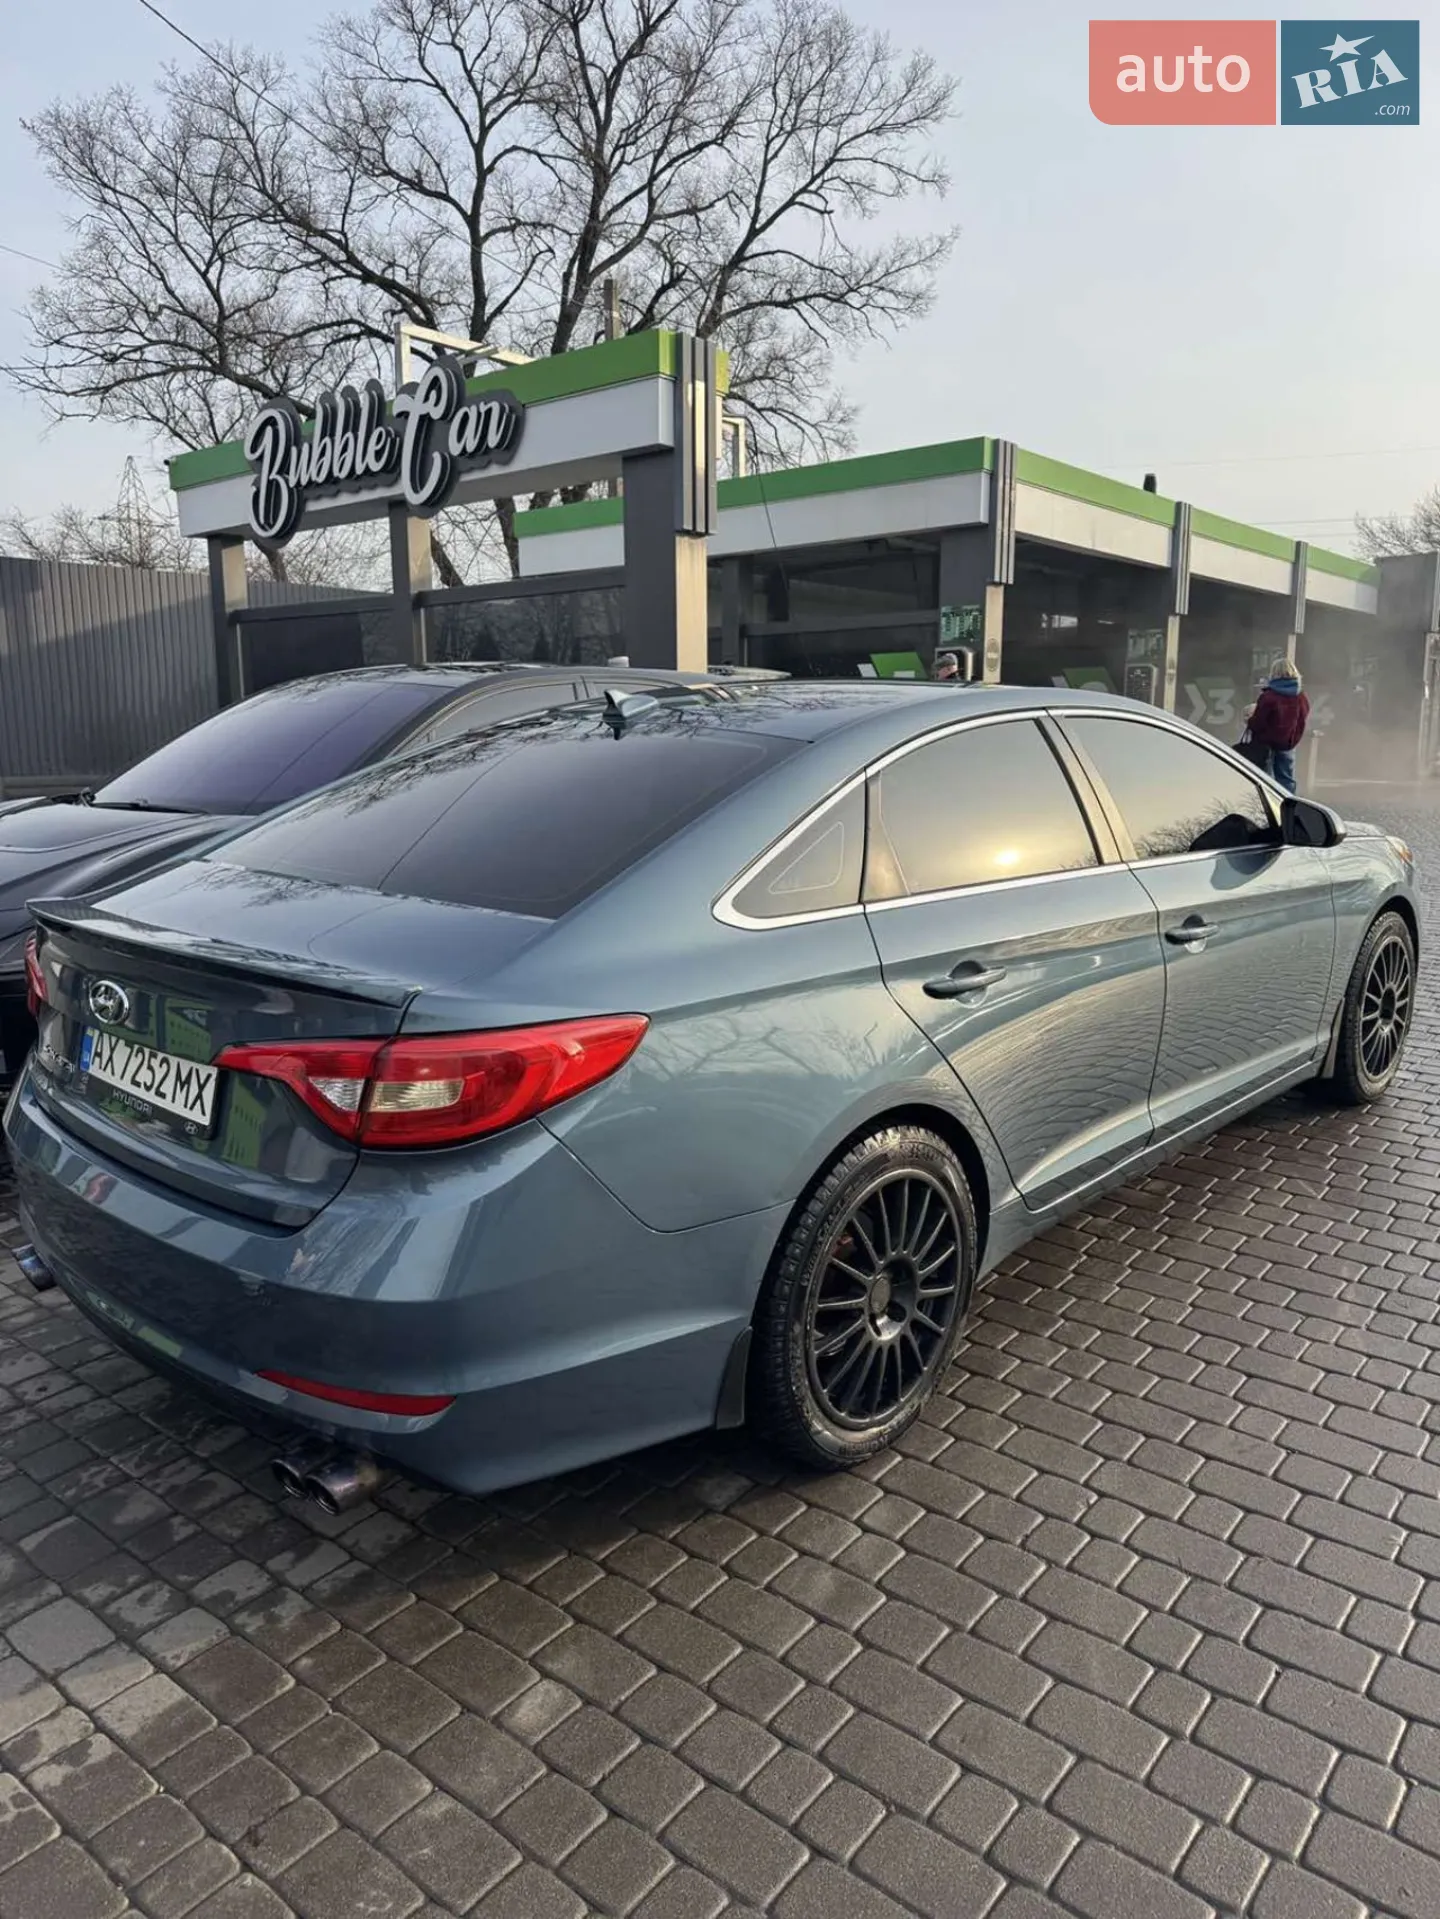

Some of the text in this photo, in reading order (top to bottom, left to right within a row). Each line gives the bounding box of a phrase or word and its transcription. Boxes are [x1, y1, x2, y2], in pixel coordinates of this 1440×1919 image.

[244, 364, 513, 539] Bubble Car
[92, 1032, 212, 1116] AX 7252 MX
